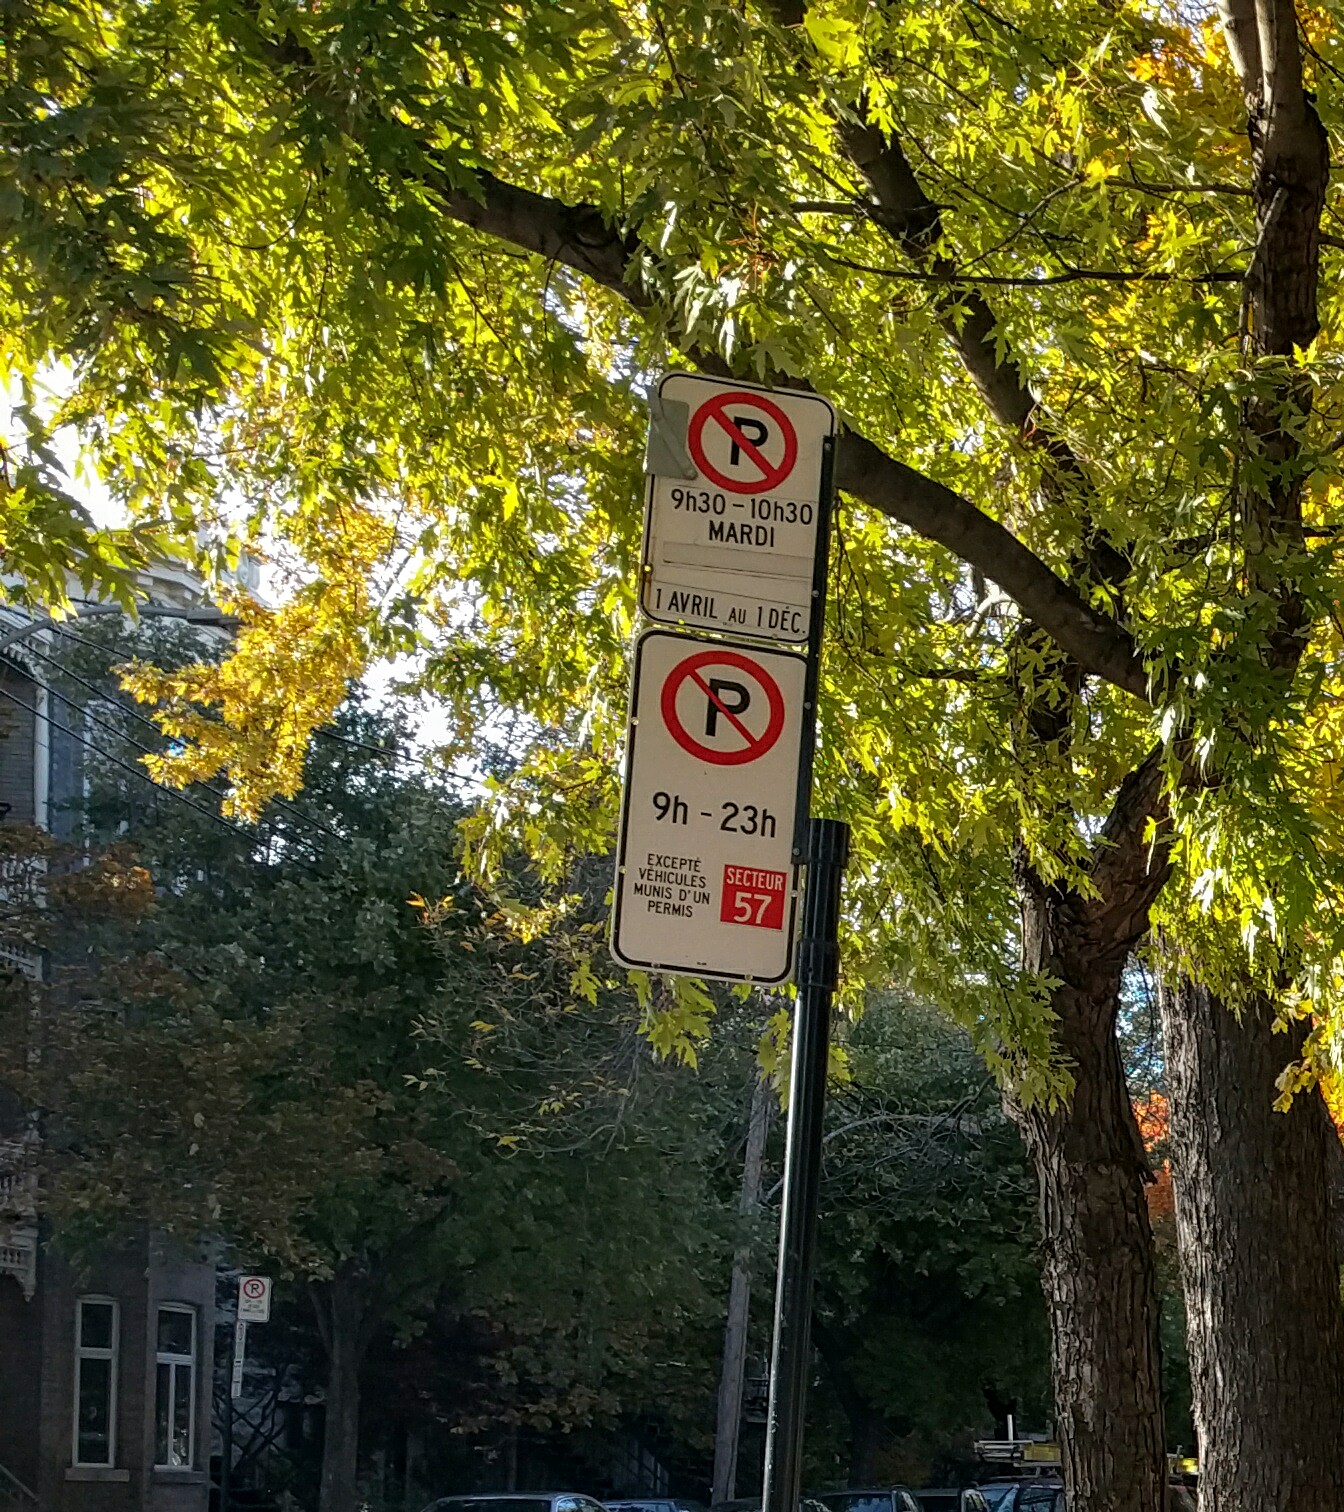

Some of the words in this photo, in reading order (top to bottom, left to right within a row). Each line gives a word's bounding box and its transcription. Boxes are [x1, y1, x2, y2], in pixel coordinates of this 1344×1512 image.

[730, 416, 768, 466] P
[671, 488, 726, 515] 9h30
[750, 498, 813, 526] 10h30
[709, 520, 775, 548] MARDI
[656, 588, 662, 609] 1
[668, 592, 718, 620] AVRIL
[728, 607, 747, 625] AU
[757, 607, 763, 628] 1
[768, 606, 807, 635] DÉC.
[705, 678, 751, 737] P
[653, 791, 688, 826] 9h
[720, 802, 777, 838] 23h
[638, 866, 707, 889] VÉHICULES
[647, 853, 702, 873] EXCEPTÉ
[633, 882, 673, 900] MUNIS
[679, 888, 711, 905] D'UN
[726, 868, 783, 891] SECTEUR
[647, 900, 693, 918] PERMIS
[733, 891, 772, 924] 57
